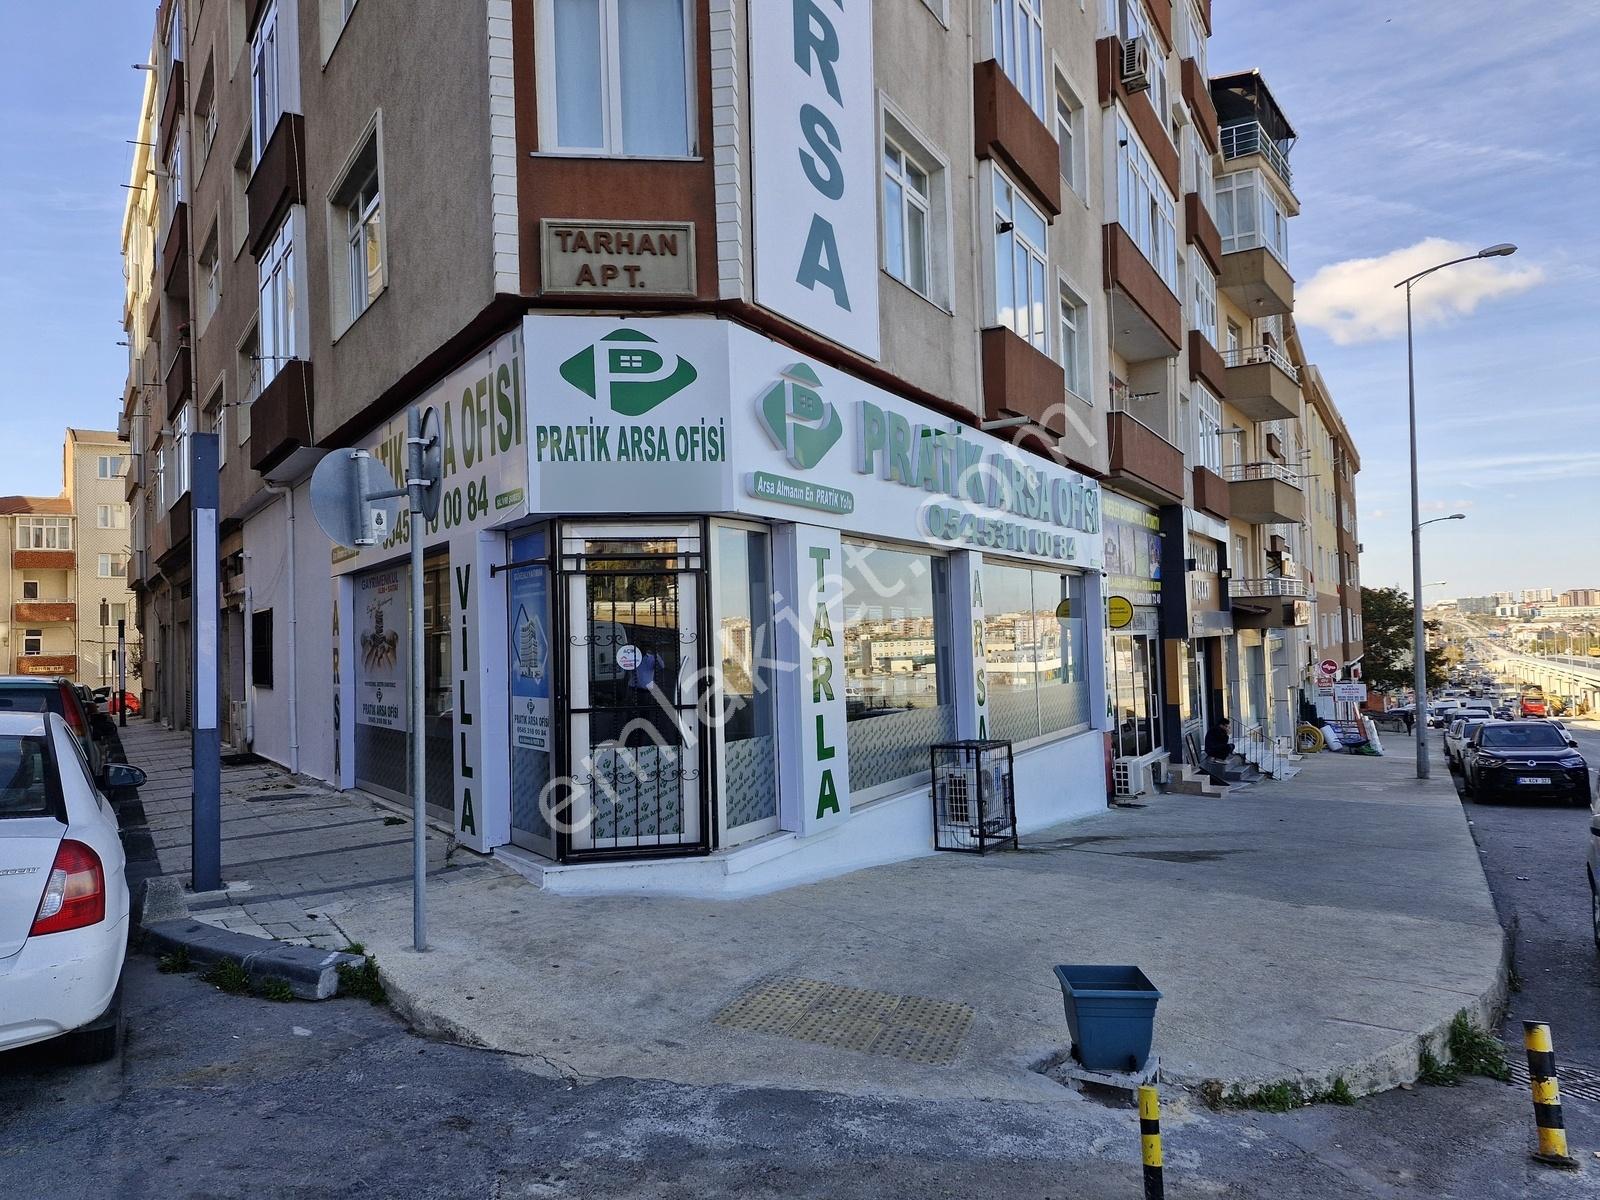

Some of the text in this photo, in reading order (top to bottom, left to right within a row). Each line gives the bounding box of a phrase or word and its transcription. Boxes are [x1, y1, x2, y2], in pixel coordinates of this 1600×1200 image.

[793, 0, 852, 313] RSA
[554, 229, 679, 256] TARHAN
[575, 263, 646, 288] APT.
[461, 333, 522, 469] OFİSİ
[536, 417, 726, 462] PRATİK ARSA OFİSİ
[857, 400, 986, 505] PRATİK
[986, 452, 1052, 523] ARSA
[1052, 474, 1100, 535] OFİSİ
[443, 486, 462, 530] 00
[467, 475, 489, 522] 84
[757, 476, 775, 494] Arsa
[776, 480, 804, 500] Almanın
[805, 487, 814, 502] En
[816, 489, 839, 507] PRATİK
[332, 599, 341, 777] ARSA
[455, 563, 476, 836] VİLLA
[808, 546, 841, 820] TARLA
[971, 569, 987, 741] ARSA
